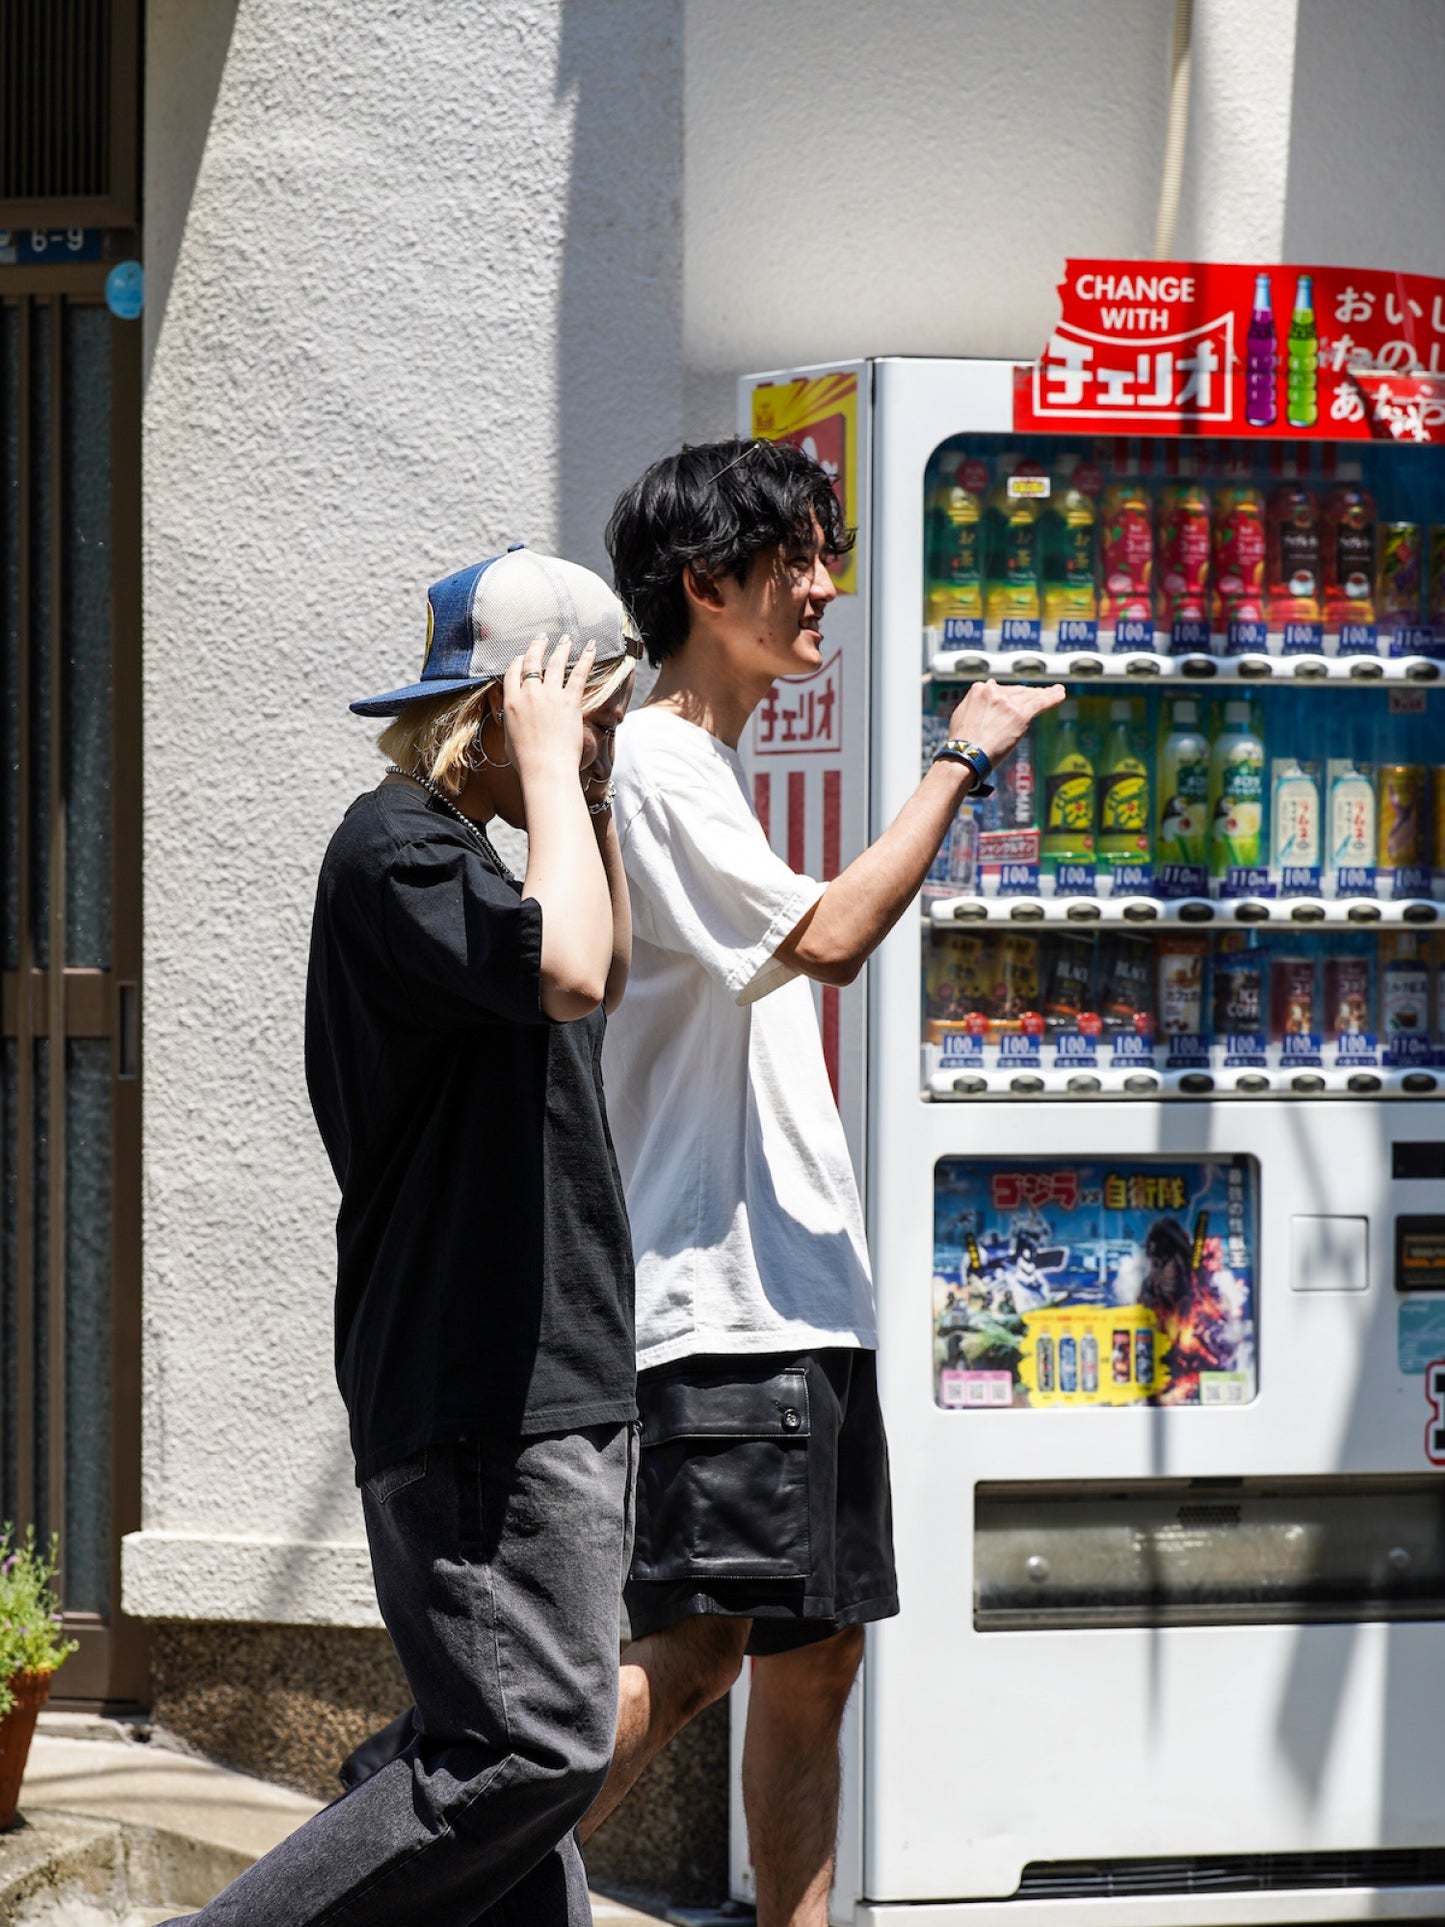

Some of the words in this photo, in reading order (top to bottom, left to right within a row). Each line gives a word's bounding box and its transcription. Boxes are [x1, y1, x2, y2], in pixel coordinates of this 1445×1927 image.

[31, 228, 85, 252] 6-9
[1076, 274, 1196, 303] CHANGE
[1102, 307, 1169, 332] WITH
[1046, 333, 1219, 408] チェリオ
[760, 676, 836, 743] チェリオ
[992, 1172, 1079, 1211] ゴジラ
[1104, 1173, 1187, 1210] 自衛隊
